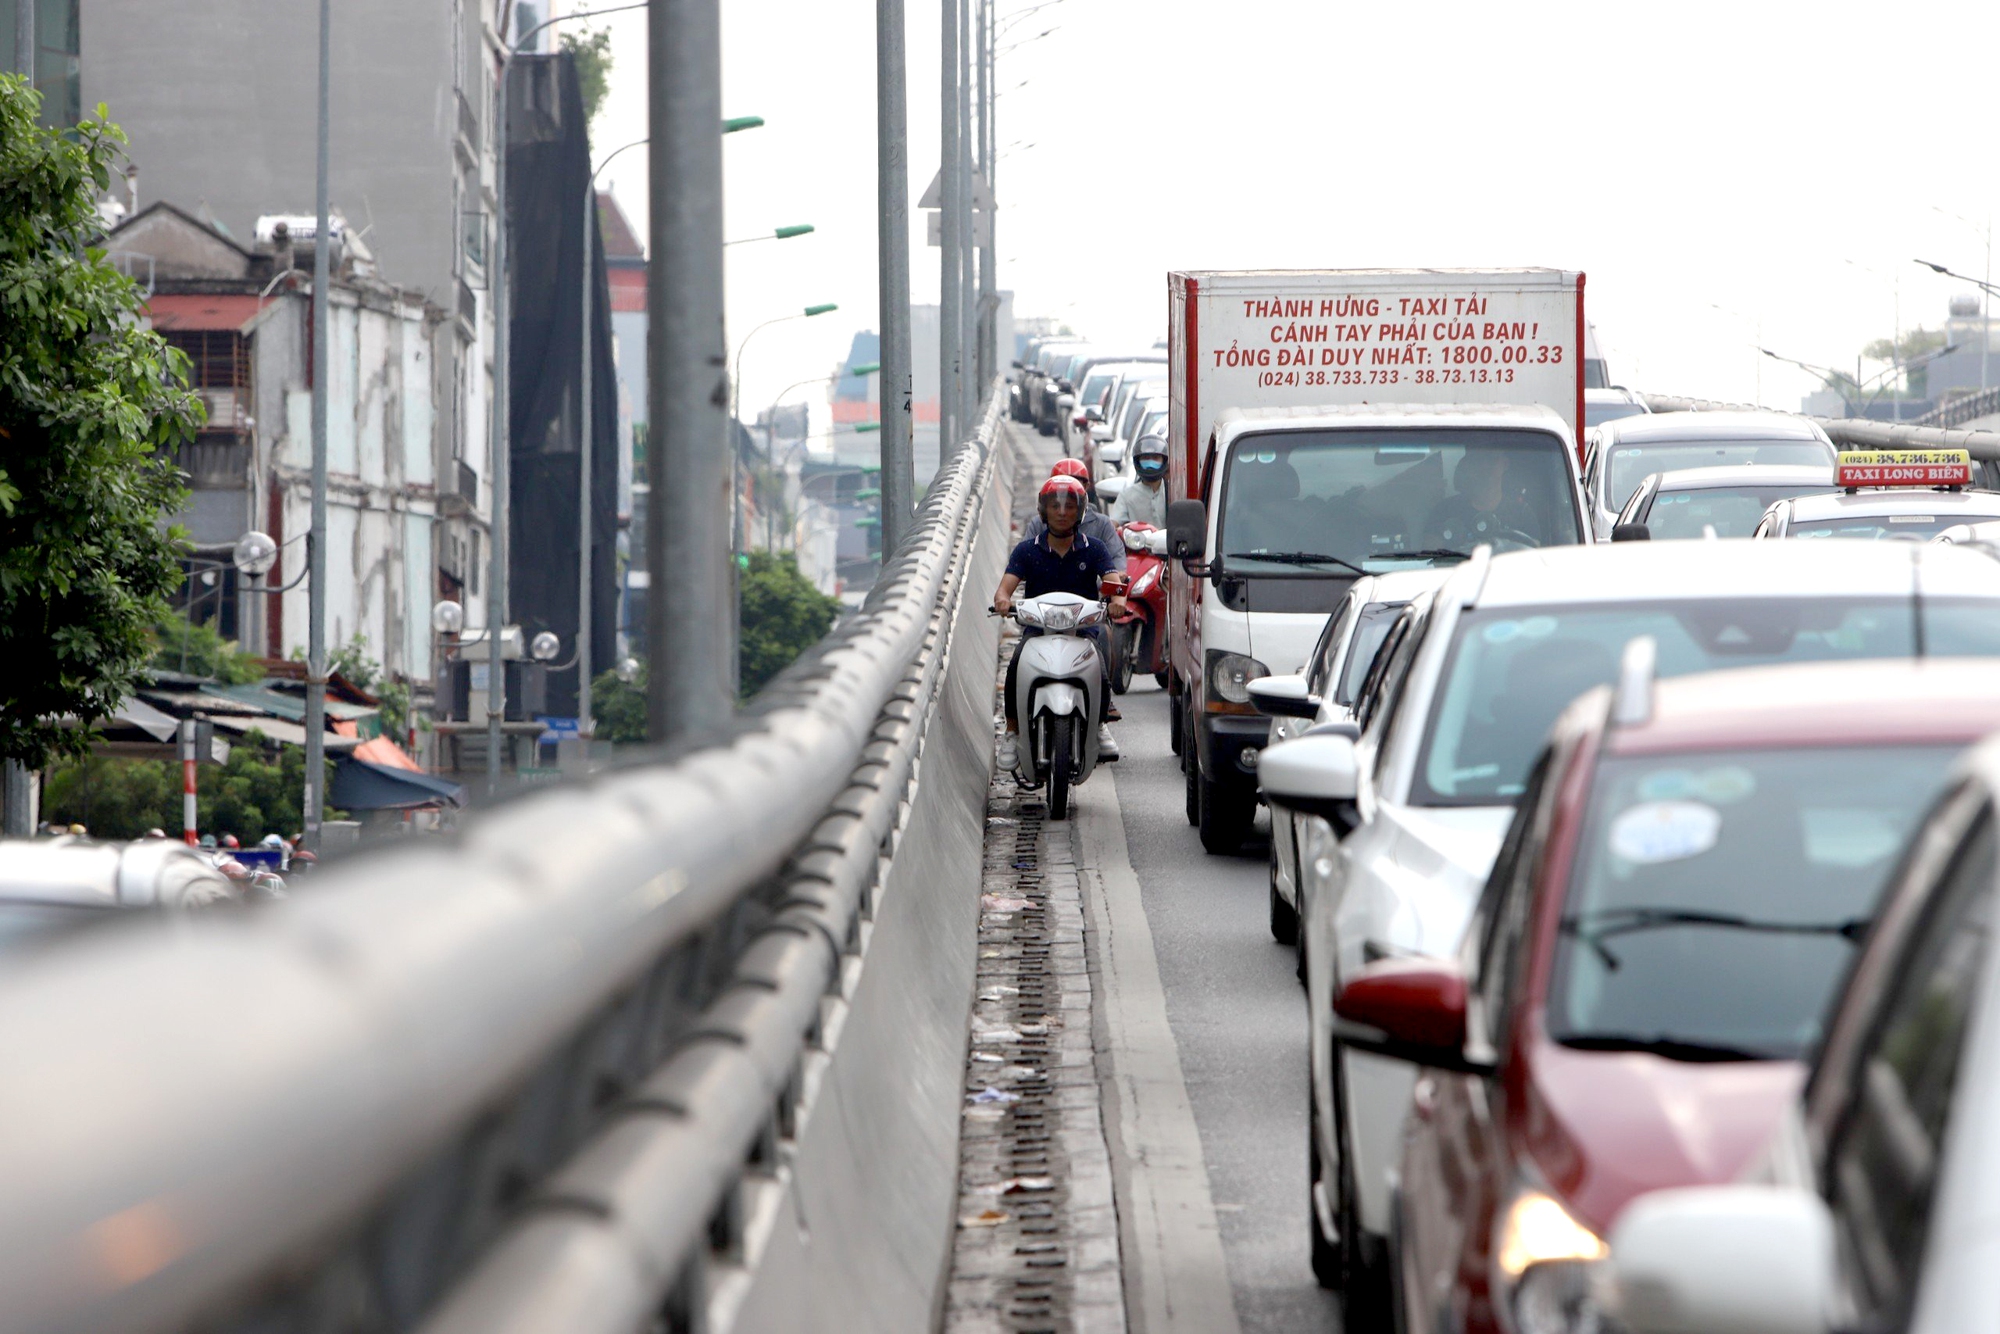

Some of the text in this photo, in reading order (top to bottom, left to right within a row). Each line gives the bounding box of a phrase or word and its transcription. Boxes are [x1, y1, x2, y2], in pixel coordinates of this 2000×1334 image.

[1243, 296, 1313, 318] THÀNH
[1320, 294, 1379, 317] HƯNG
[1454, 292, 1487, 316] TẢI
[1270, 322, 1328, 343] CÁNH
[1335, 324, 1373, 342] TAY
[1379, 318, 1426, 342] PHẢI
[1433, 318, 1475, 341] CỦA
[1213, 339, 1563, 367] TỔNG ĐÀI DUY NHẤT: 1800.00.33
[1258, 371, 1300, 388] (024)
[1305, 370, 1399, 386] 38.733.733
[1415, 369, 1514, 384] 38.73.13.13
[1876, 453, 1961, 465] 38.736.736
[1844, 465, 1964, 480] TAXI LONG BIÊN
